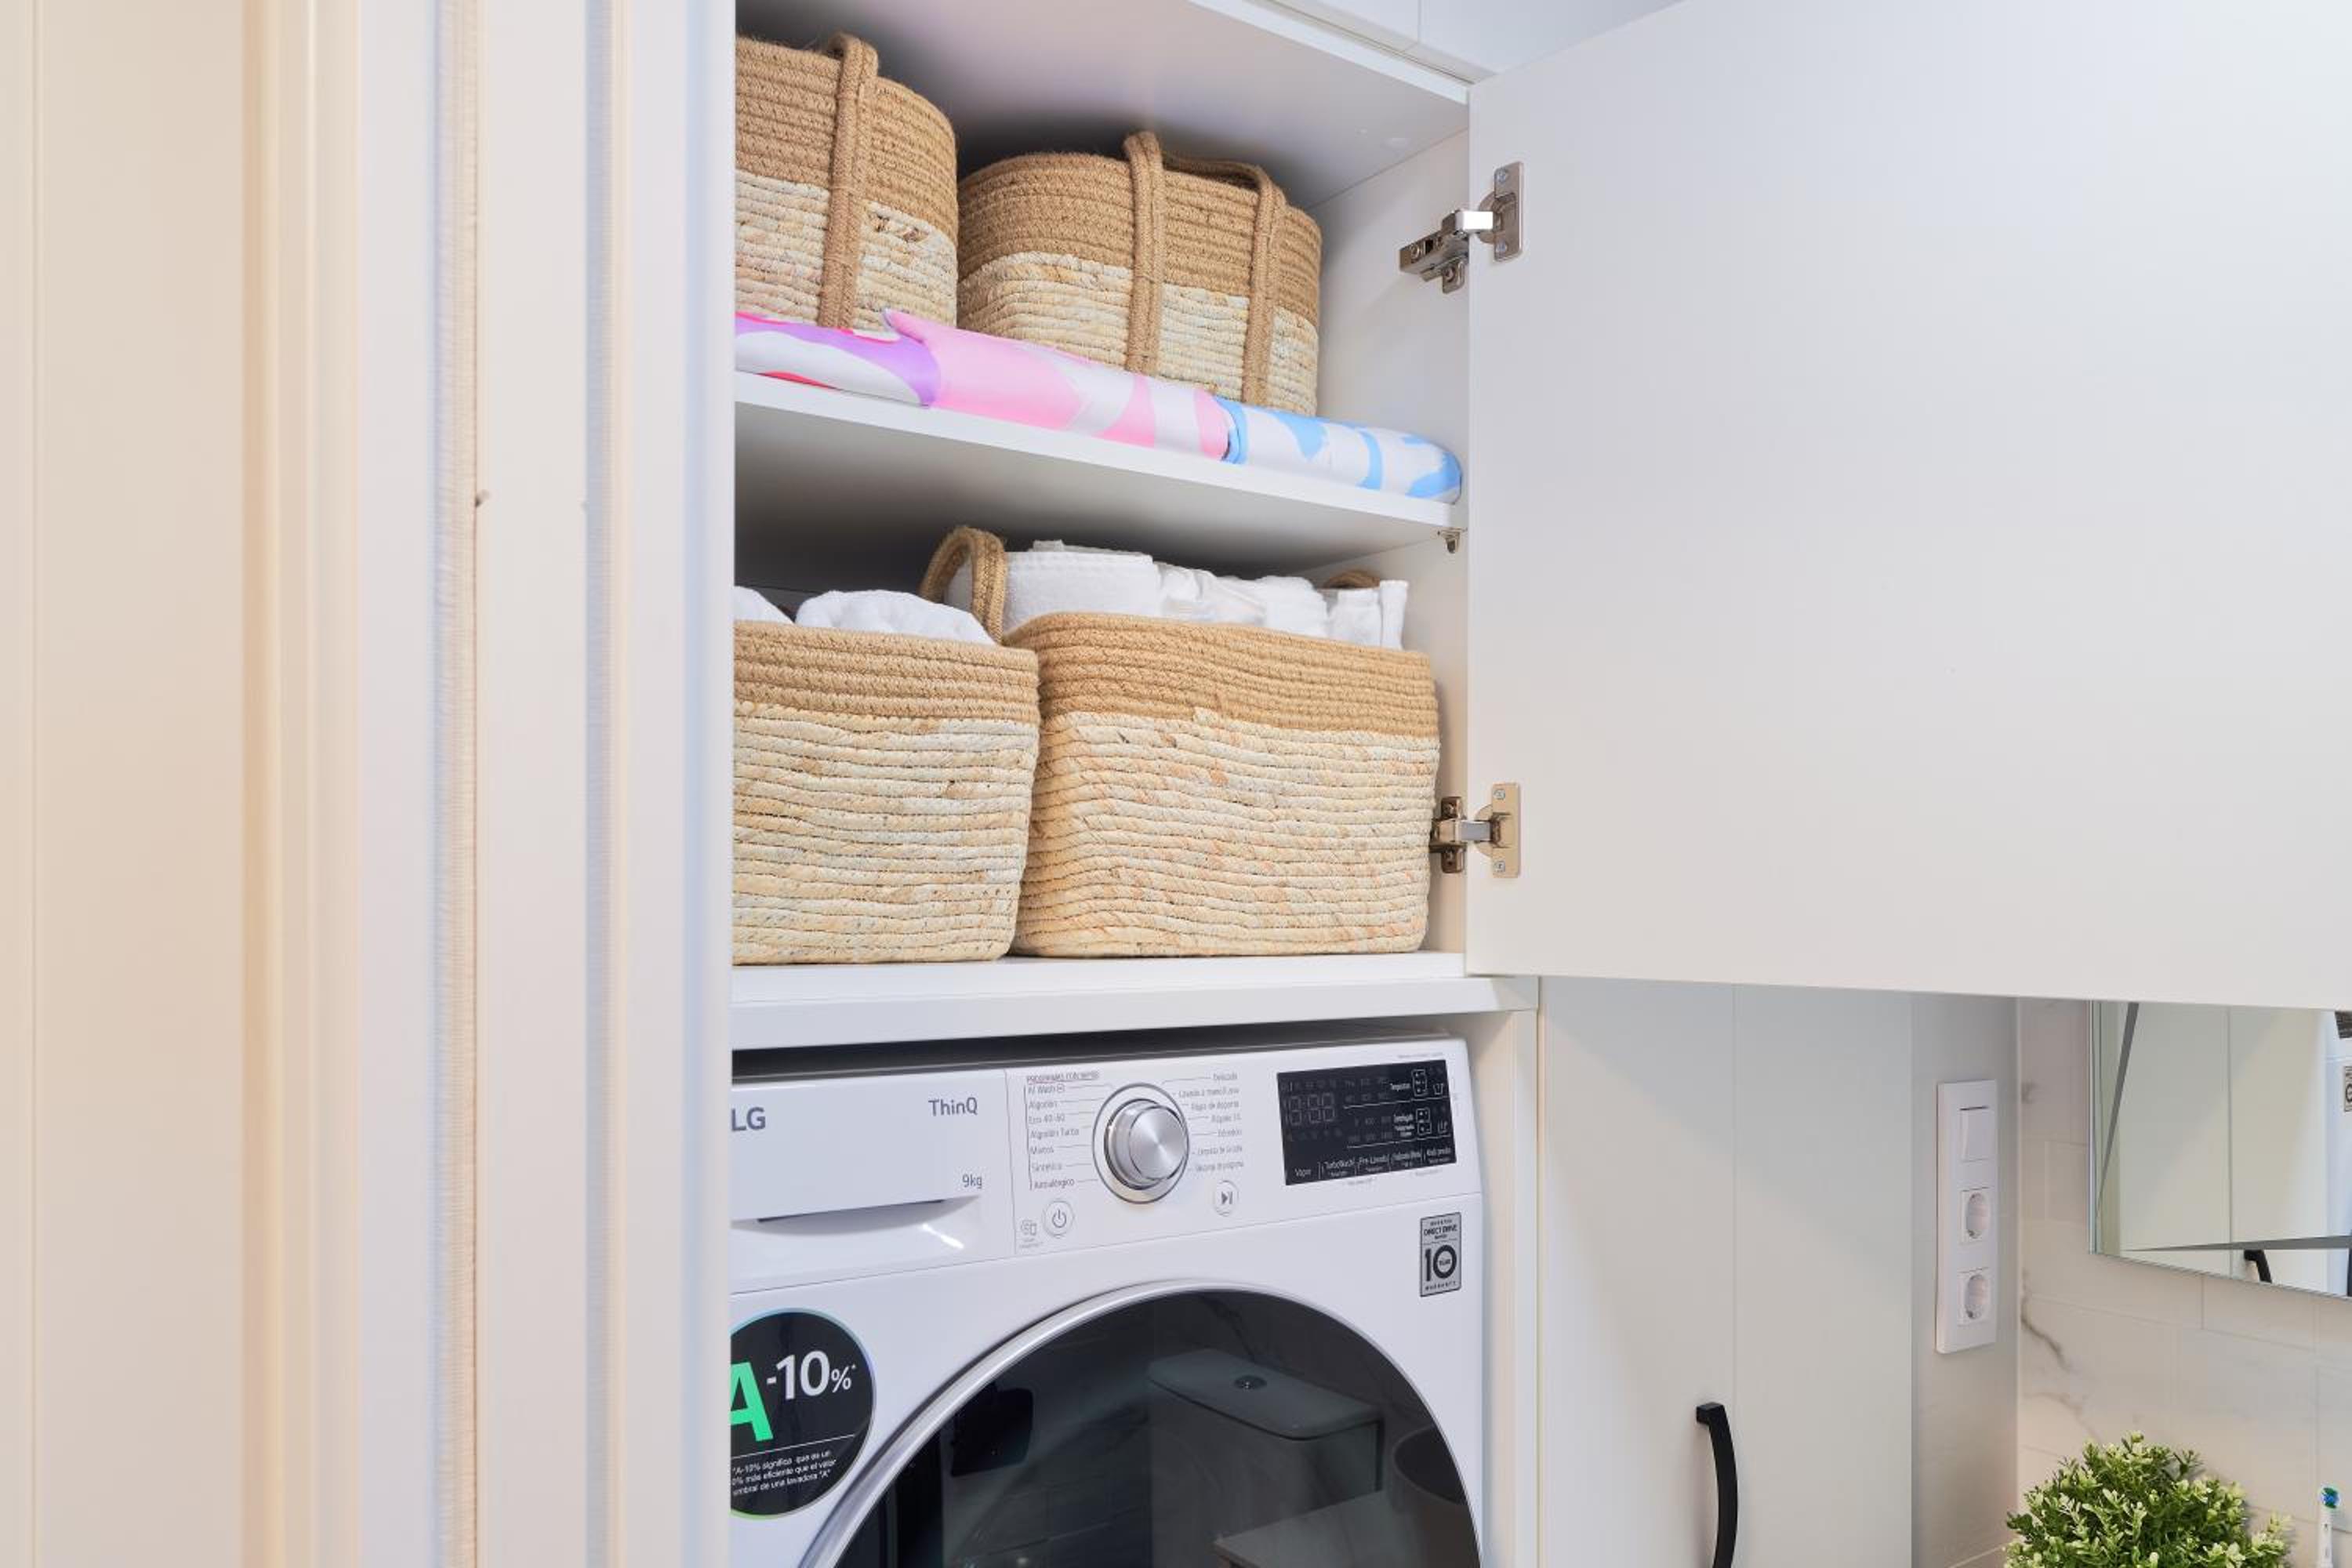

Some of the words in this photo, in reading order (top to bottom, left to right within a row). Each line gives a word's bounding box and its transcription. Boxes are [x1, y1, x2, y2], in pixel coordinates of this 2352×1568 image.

[928, 1096, 978, 1116] ThinQ
[731, 1107, 766, 1131] LG
[962, 1174, 982, 1189] 9kg
[1425, 1244, 1457, 1282] 10
[762, 1458, 793, 1471] significa
[764, 1468, 794, 1479] eficiente
[818, 1458, 837, 1469] valor
[786, 1474, 818, 1485] lavadora
